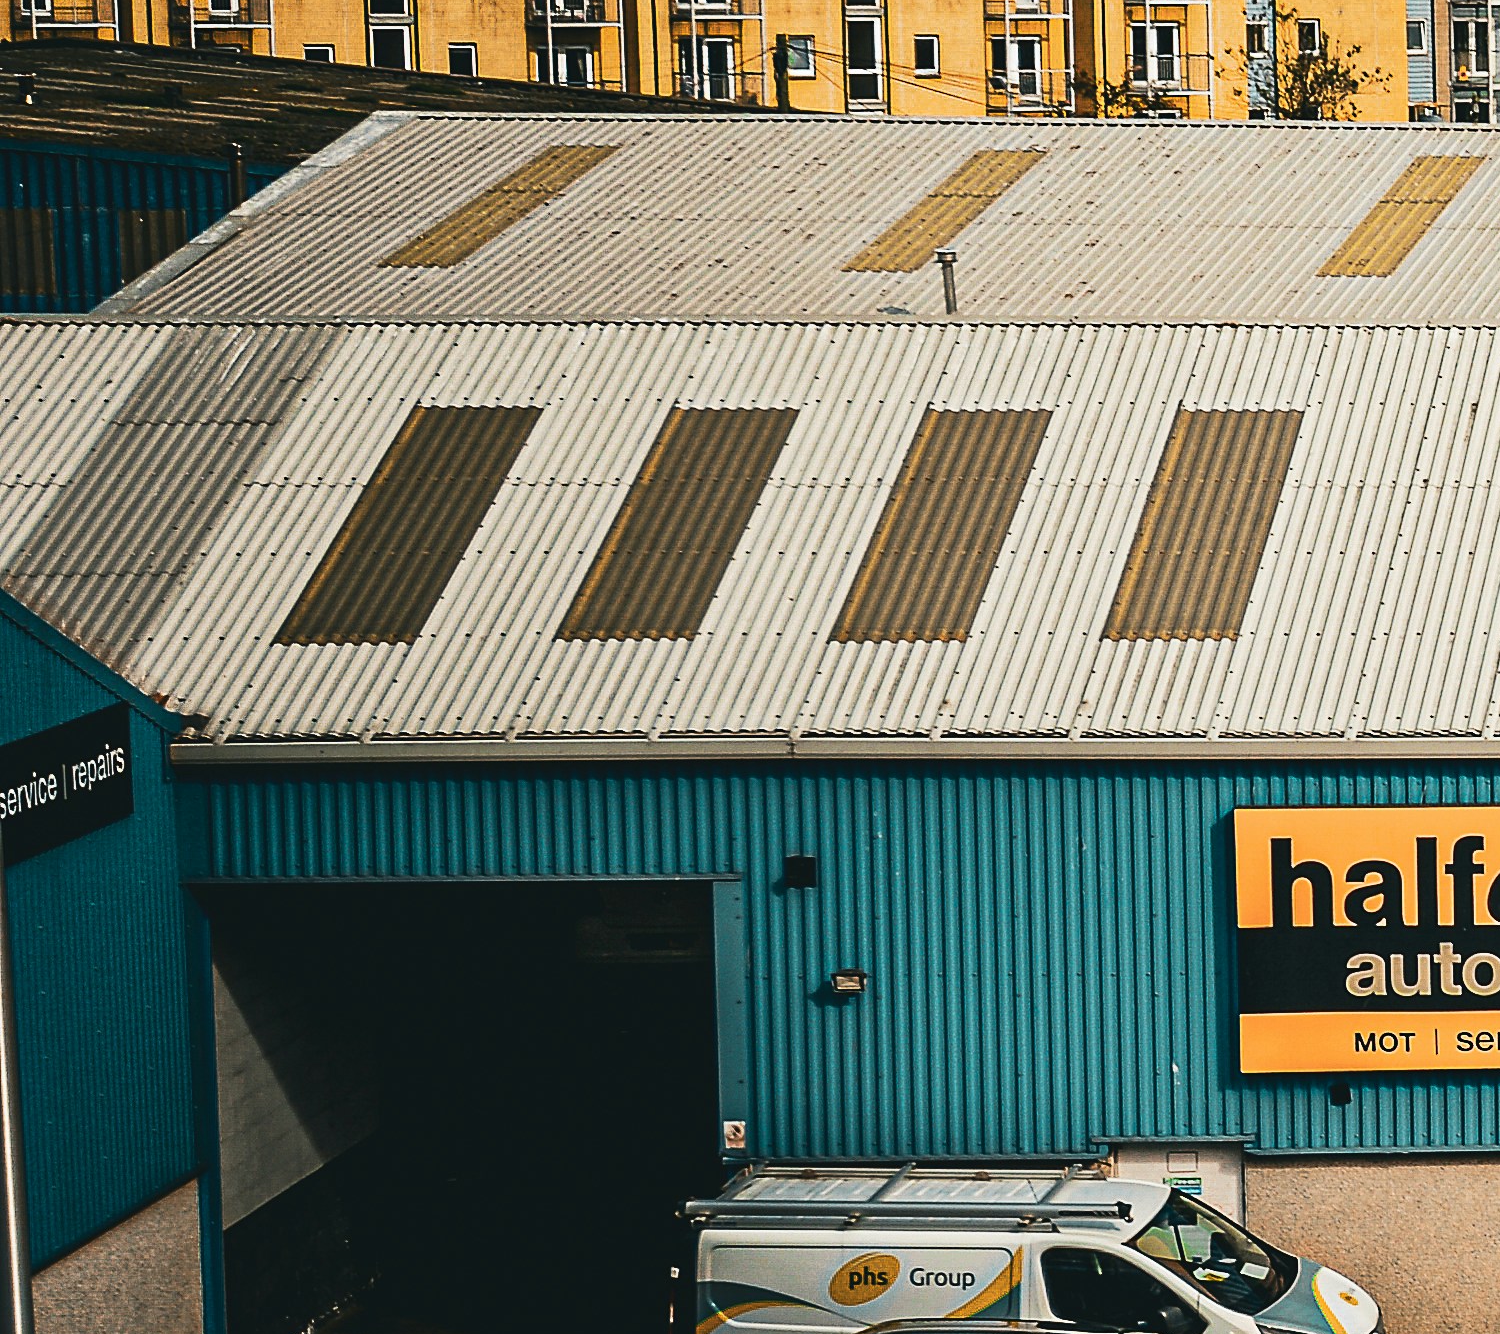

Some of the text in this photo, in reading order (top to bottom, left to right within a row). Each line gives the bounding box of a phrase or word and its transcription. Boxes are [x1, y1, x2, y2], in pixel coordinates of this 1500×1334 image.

[0, 743, 125, 819] service repairs
[1354, 1031, 1416, 1053] MOT
[849, 1266, 976, 1291] phs Group
